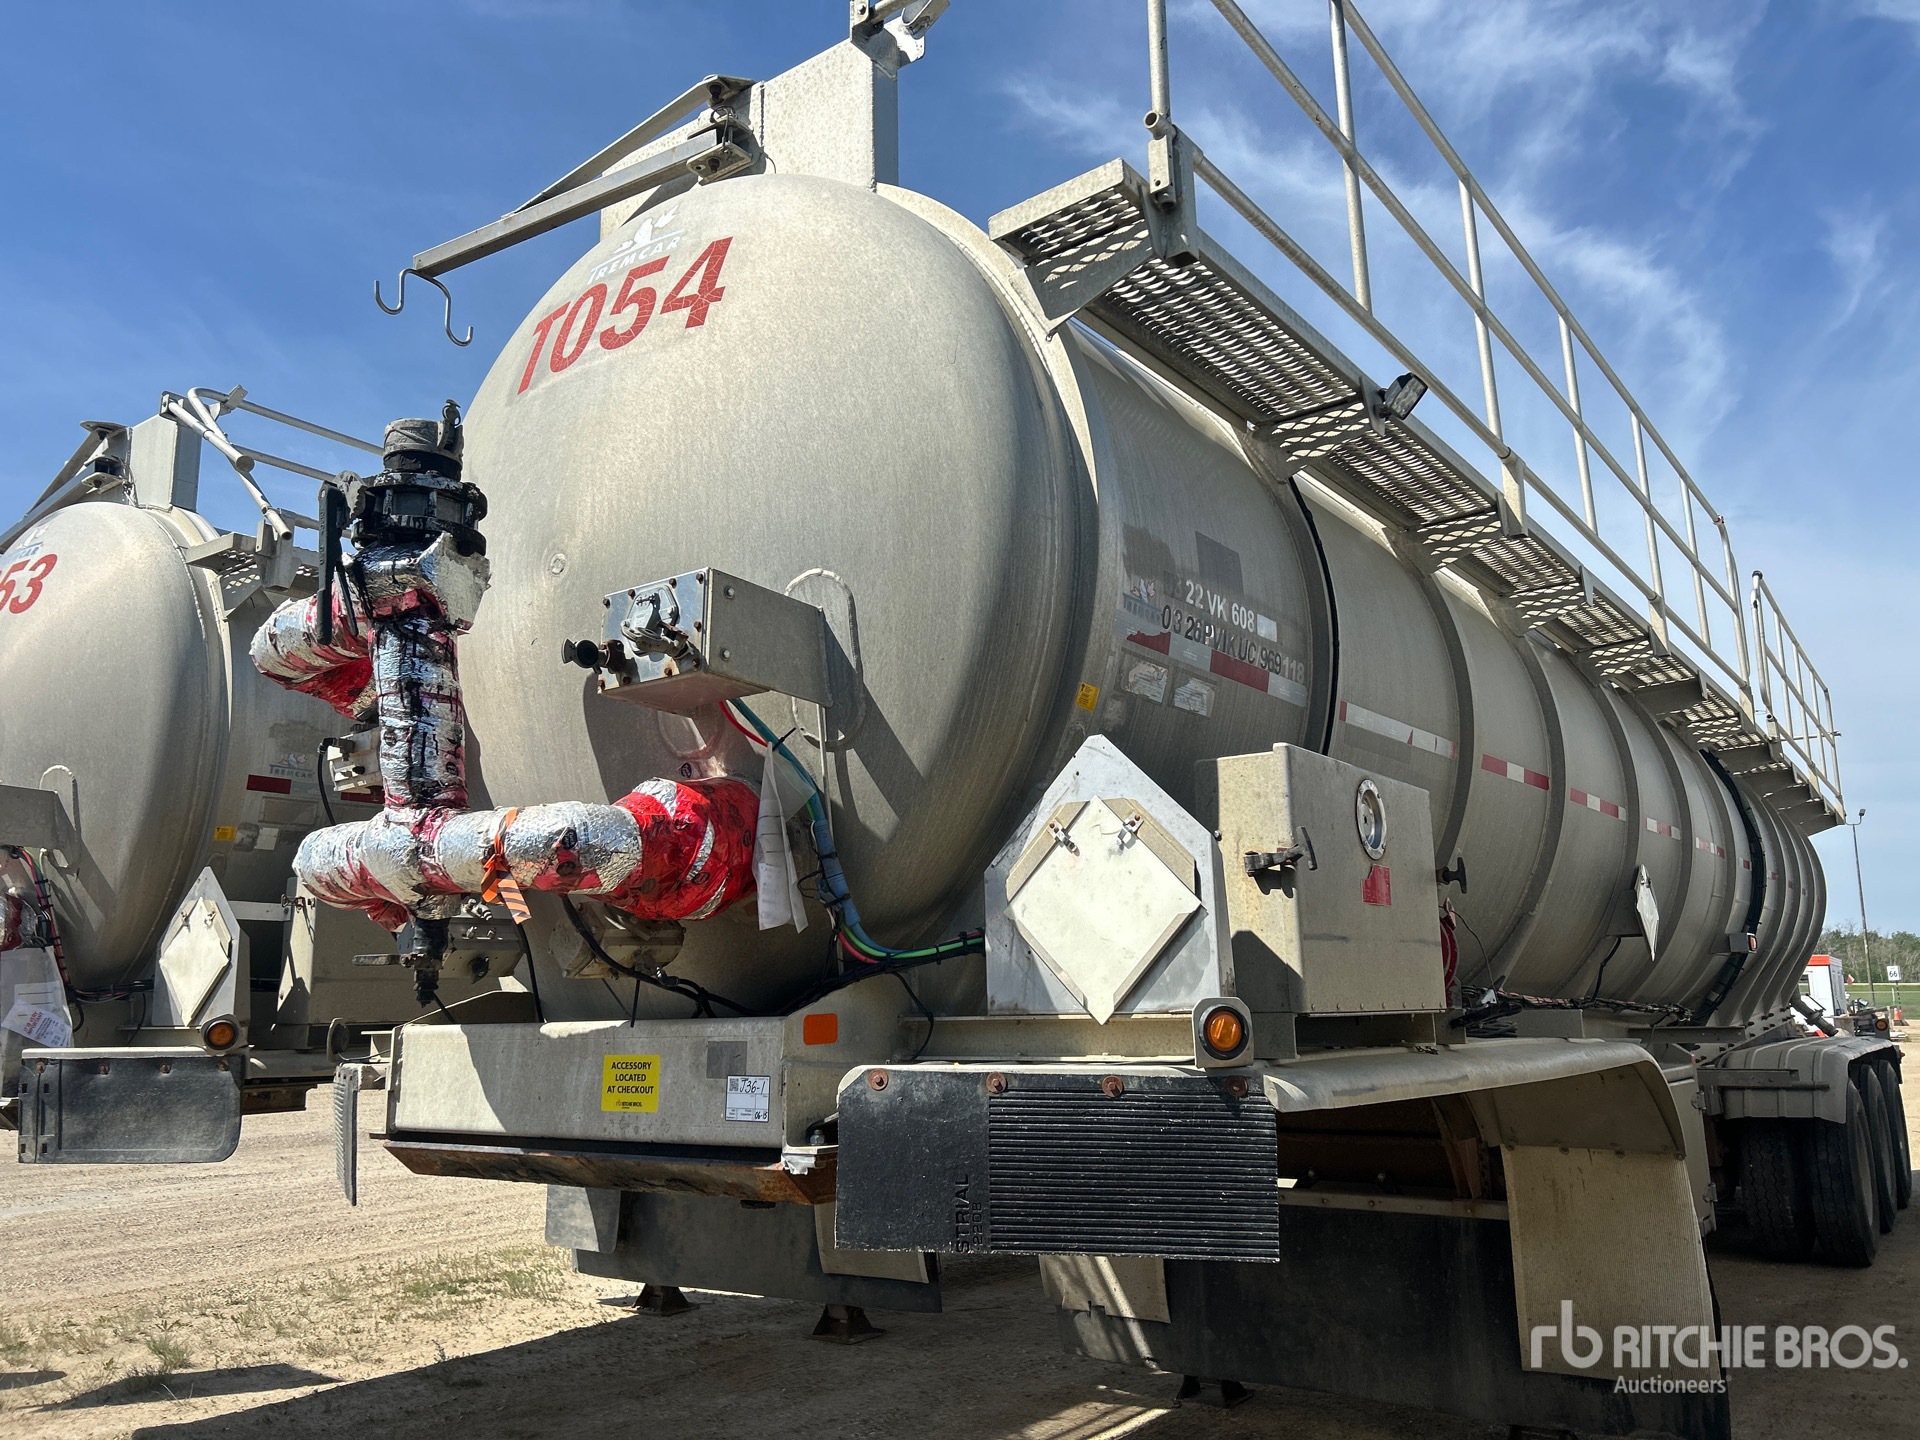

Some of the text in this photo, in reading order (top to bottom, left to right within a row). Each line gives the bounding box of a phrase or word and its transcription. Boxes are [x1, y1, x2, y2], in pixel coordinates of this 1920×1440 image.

[587, 232, 682, 285] TREMCAR
[517, 236, 733, 395] T054
[0, 553, 58, 614] 53
[1185, 579, 1204, 610] 22
[1206, 589, 1228, 622] VK
[1230, 602, 1255, 633] 608
[606, 1085, 654, 1094] AT CHECKOUT
[611, 1061, 652, 1070] ACCESSORY
[615, 1073, 647, 1082] LOCATED
[955, 1173, 970, 1253] STRIAL
